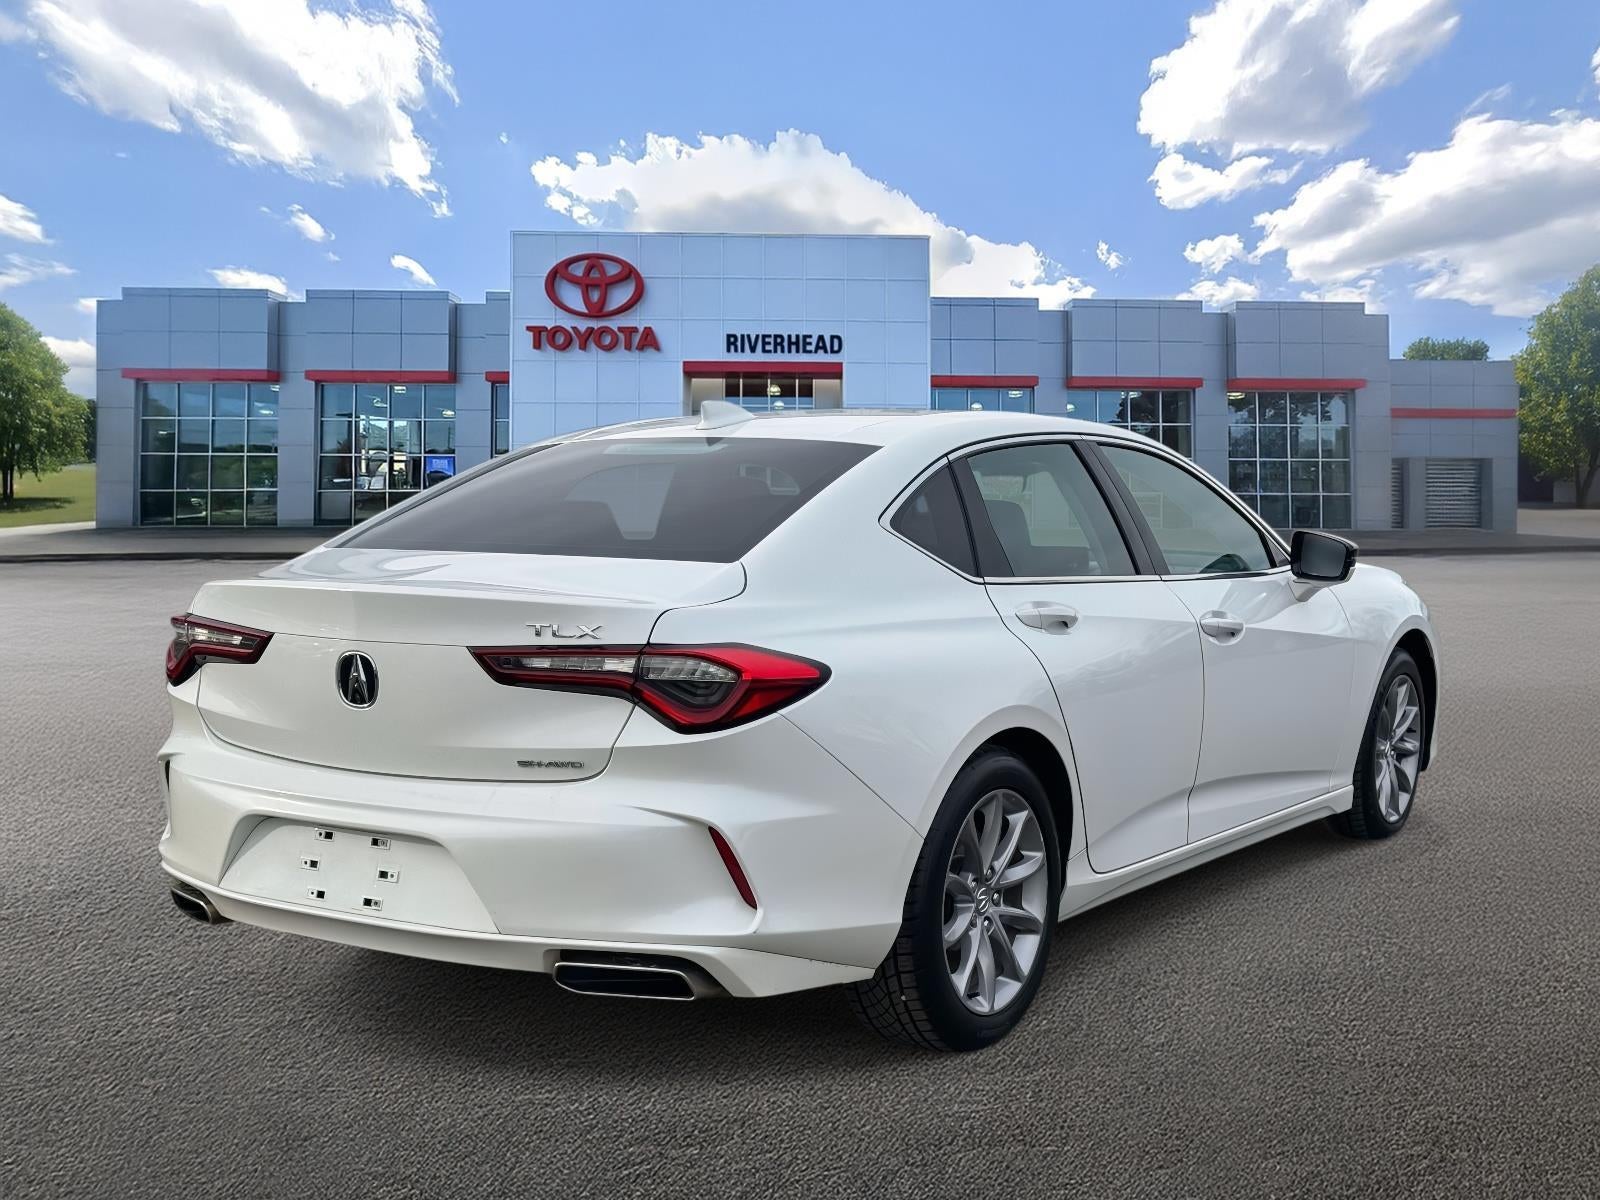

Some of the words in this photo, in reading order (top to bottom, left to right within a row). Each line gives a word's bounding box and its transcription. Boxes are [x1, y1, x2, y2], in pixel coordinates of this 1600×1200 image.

[526, 325, 661, 352] TOYOTA
[726, 334, 842, 354] RIVERHEAD
[526, 623, 602, 639] TLX
